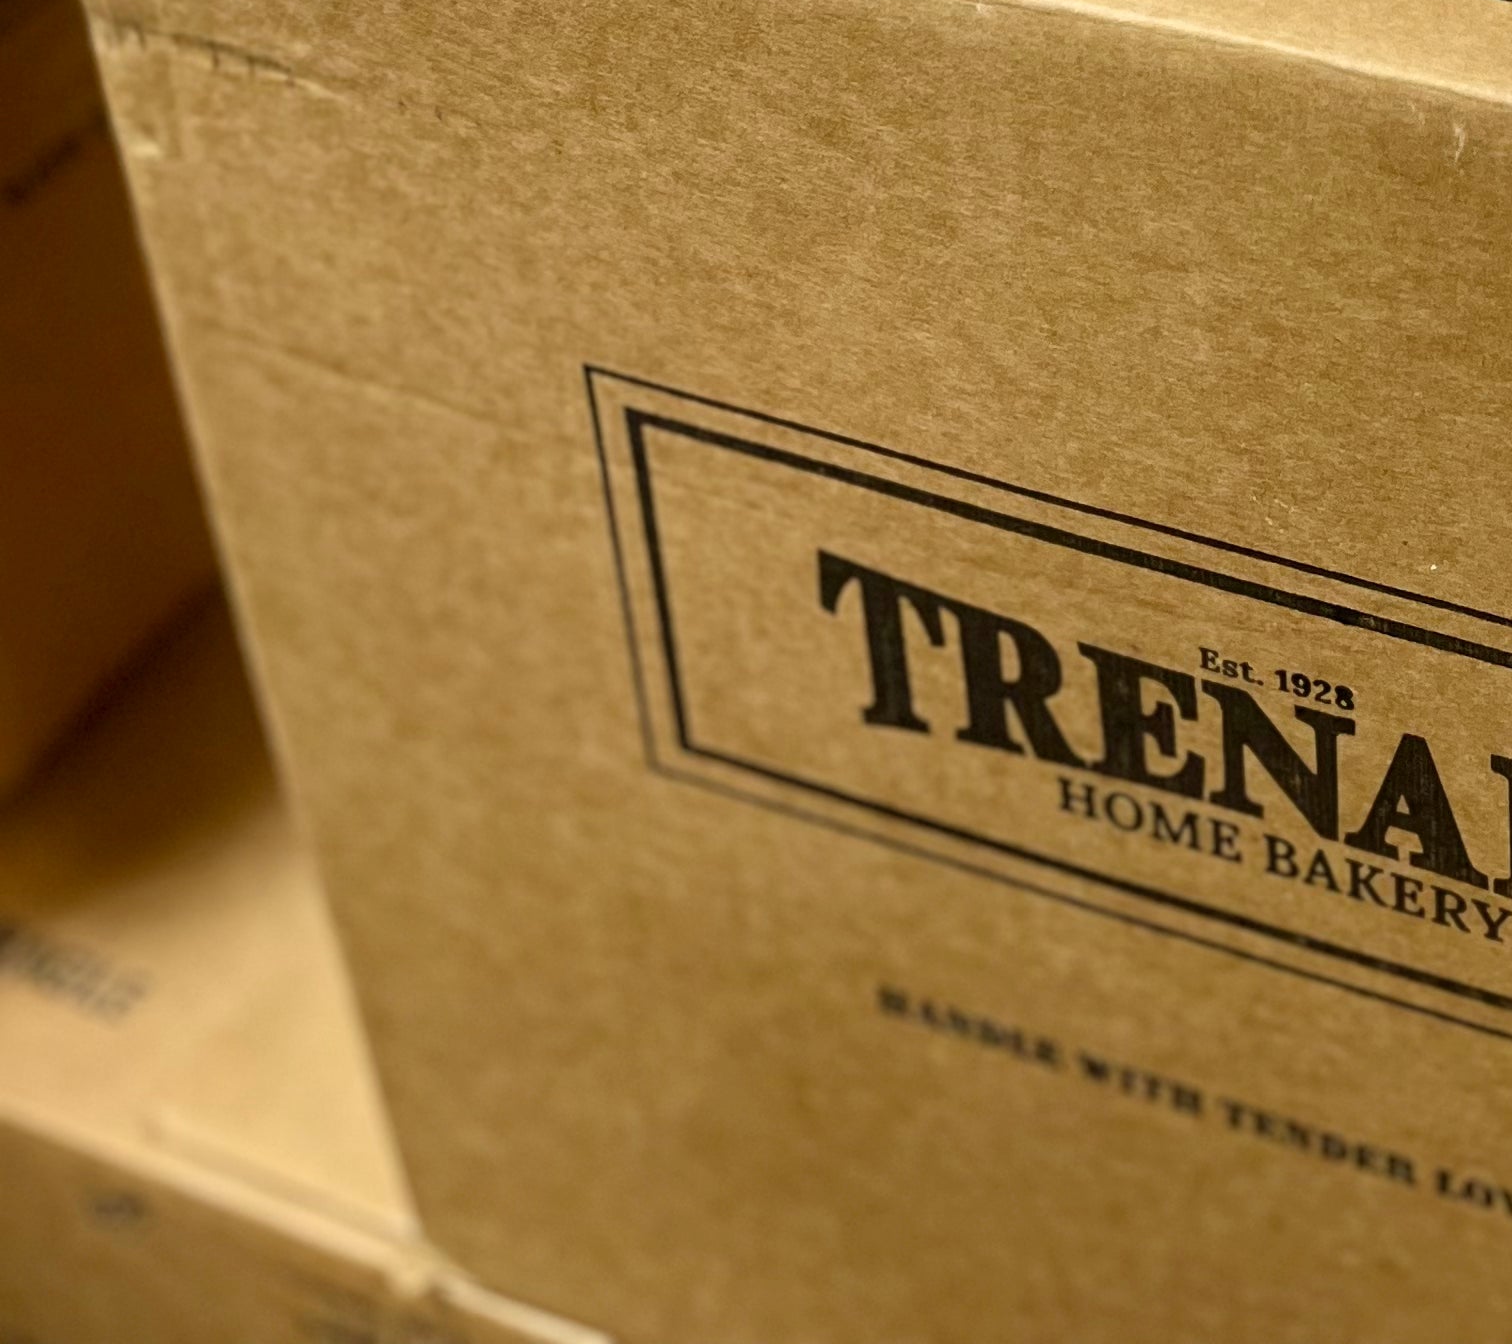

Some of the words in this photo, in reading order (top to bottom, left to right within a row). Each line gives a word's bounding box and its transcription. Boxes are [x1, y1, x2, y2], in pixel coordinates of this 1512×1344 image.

[1198, 646, 1265, 687] Est.
[1274, 669, 1356, 711] 1928
[1057, 777, 1244, 863] HOME
[1078, 1052, 1203, 1118] WITH
[1220, 1096, 1416, 1188] TENDER
